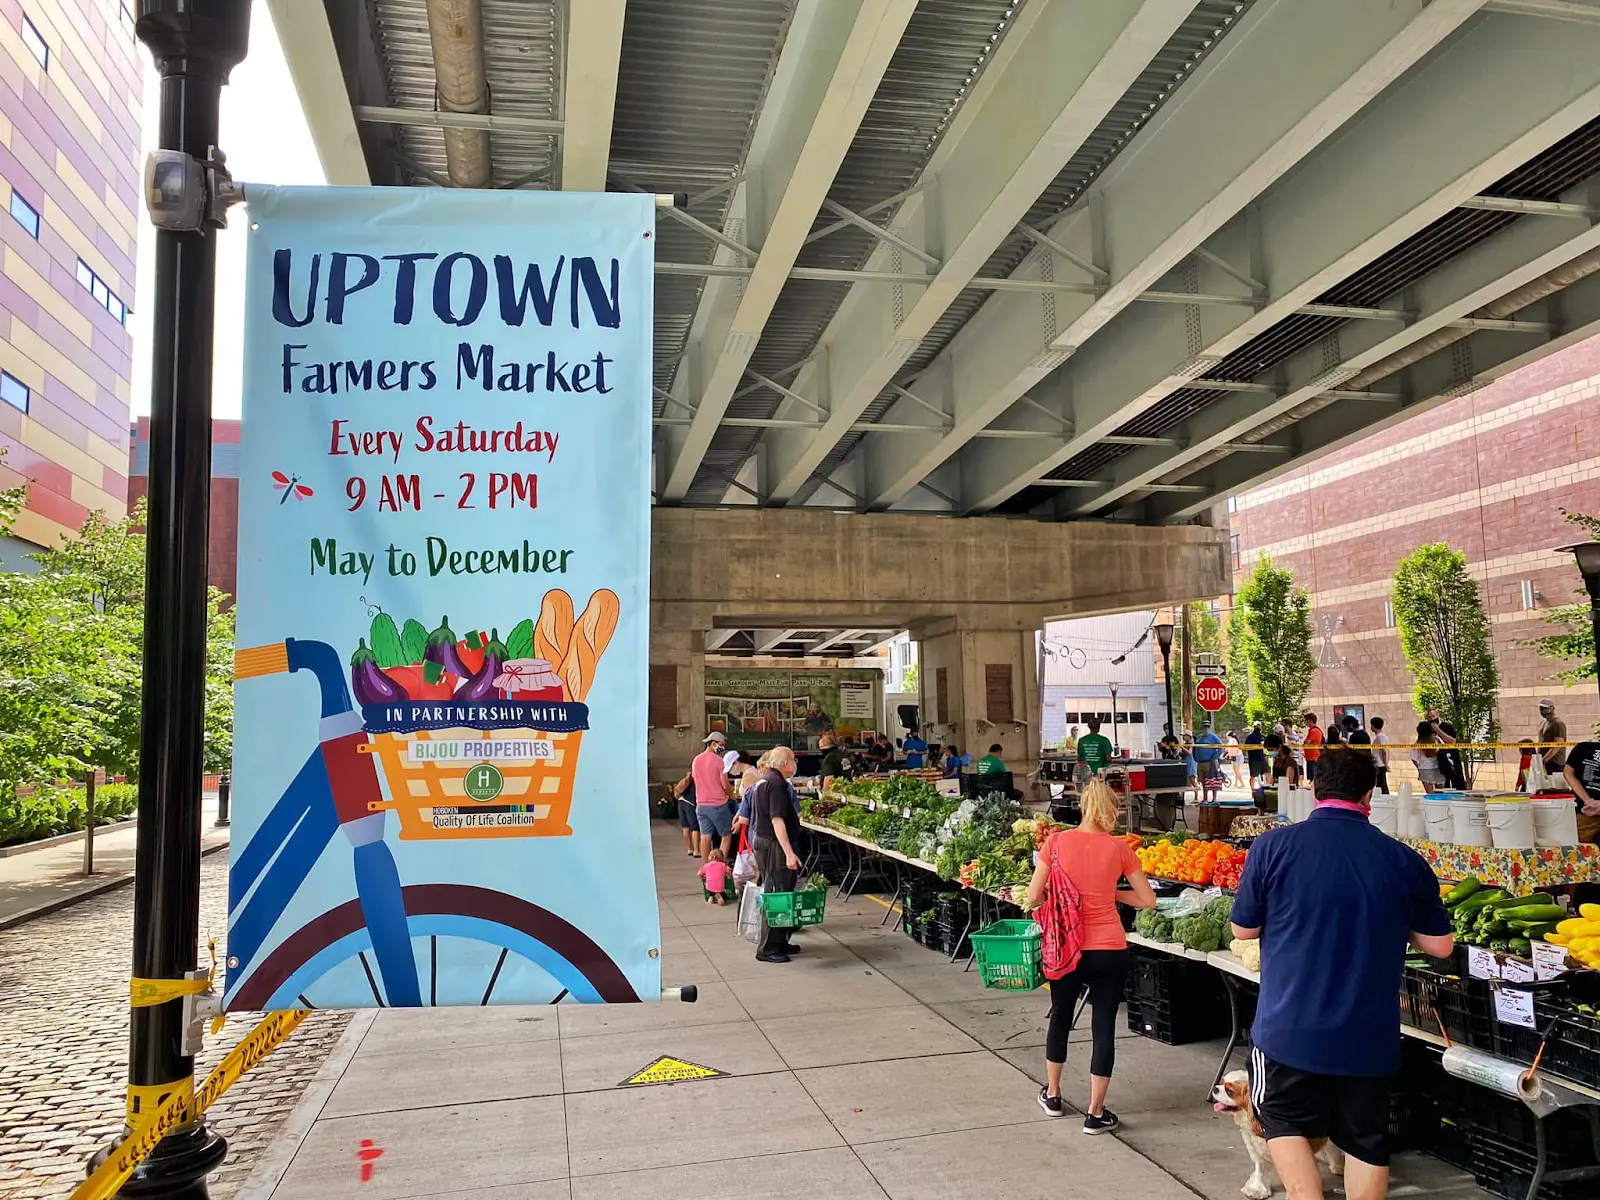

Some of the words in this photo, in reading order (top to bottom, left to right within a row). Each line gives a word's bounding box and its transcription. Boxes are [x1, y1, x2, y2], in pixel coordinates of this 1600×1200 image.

[272, 248, 621, 329] UPTOWN
[281, 344, 436, 394] Farmers
[456, 342, 614, 394] Market
[328, 419, 403, 463] Every
[414, 415, 559, 462] Saturday
[345, 476, 367, 512] 9
[378, 474, 421, 512] AM
[457, 472, 476, 509] 2
[488, 473, 538, 509] PM
[309, 537, 375, 586] May
[386, 543, 416, 577] to
[426, 536, 574, 577] December
[1198, 687, 1226, 701] STOP
[386, 708, 403, 722] IN
[412, 706, 524, 722] PARTNERSHIP
[531, 707, 567, 722] WITH
[415, 742, 458, 759] BIJOU
[463, 742, 549, 757] PROPERTIES
[478, 770, 490, 787] H
[433, 806, 459, 815] HOBOKEN
[432, 814, 462, 829] Quality
[466, 814, 477, 826] Of
[478, 813, 495, 826] Life
[497, 813, 534, 826] Coalition
